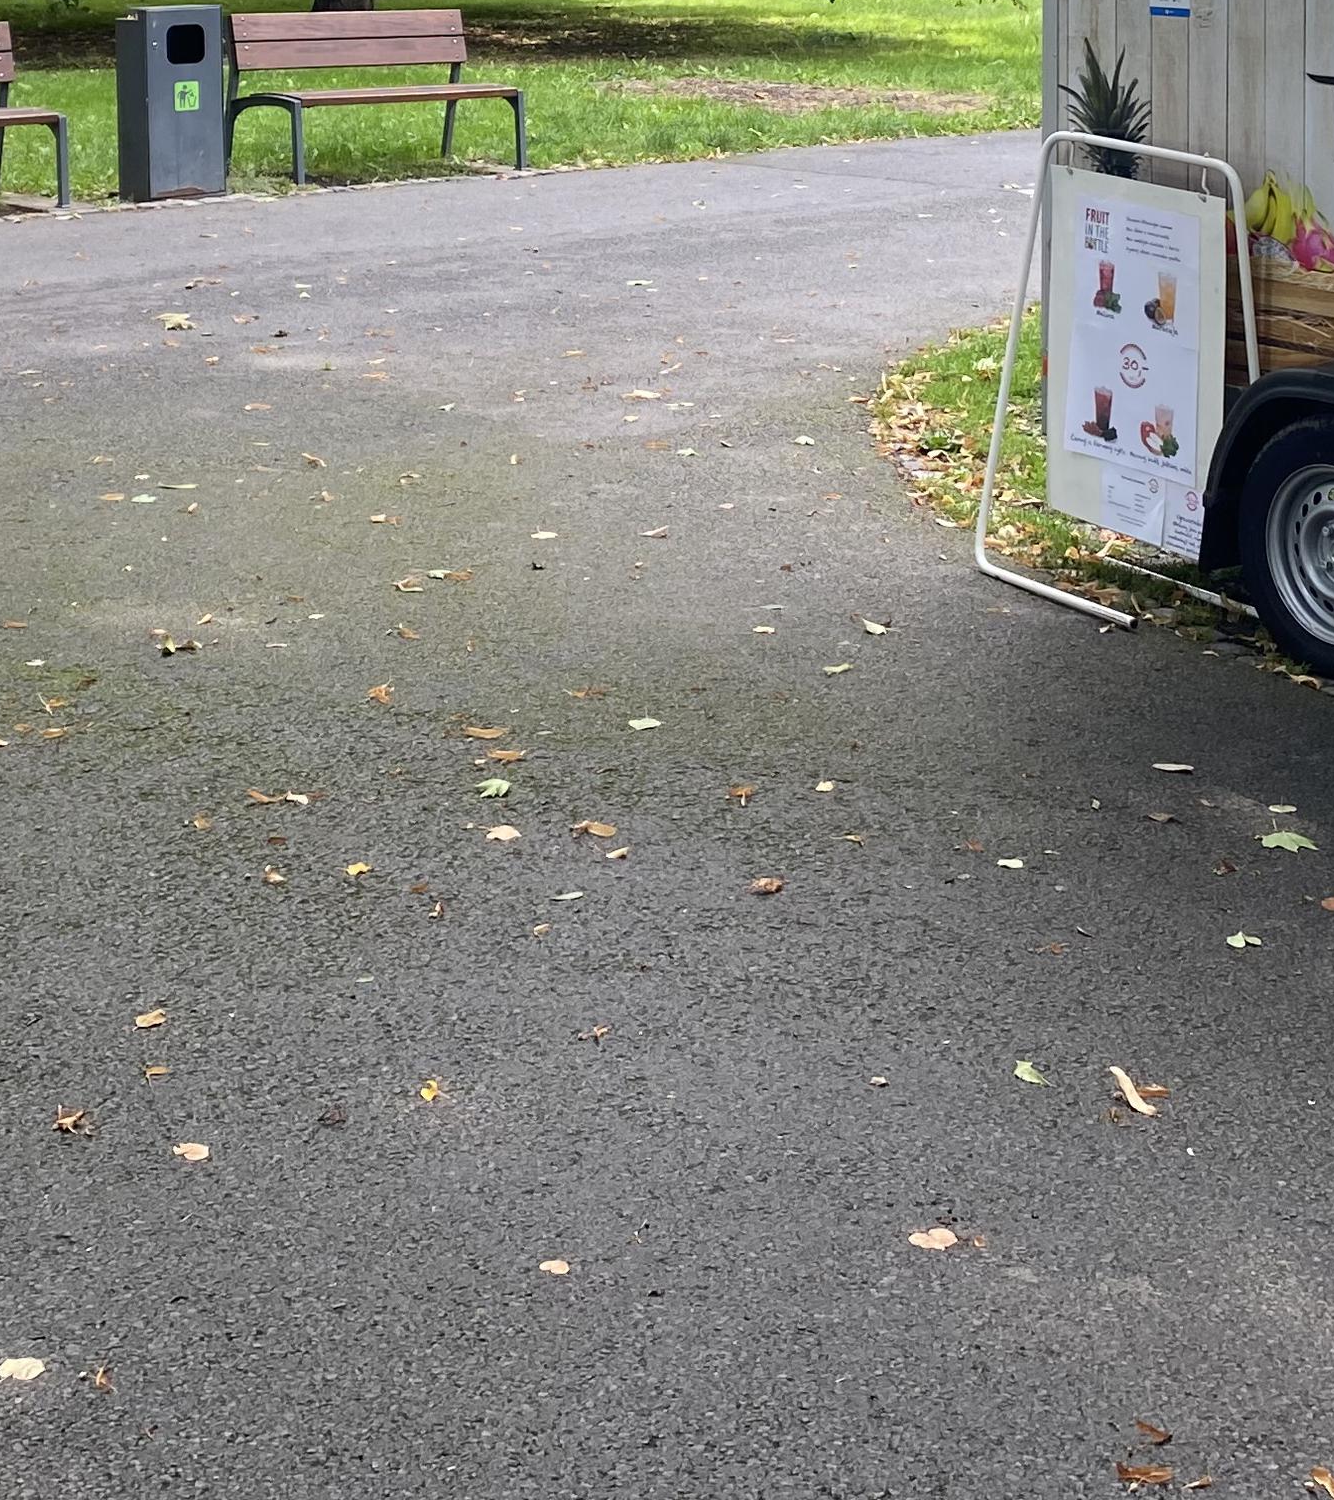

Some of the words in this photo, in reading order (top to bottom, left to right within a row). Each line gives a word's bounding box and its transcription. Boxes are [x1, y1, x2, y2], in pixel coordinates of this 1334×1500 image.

[1085, 207, 1110, 226] FRUIT
[1084, 225, 1094, 237] IN
[1095, 226, 1109, 240] THE
